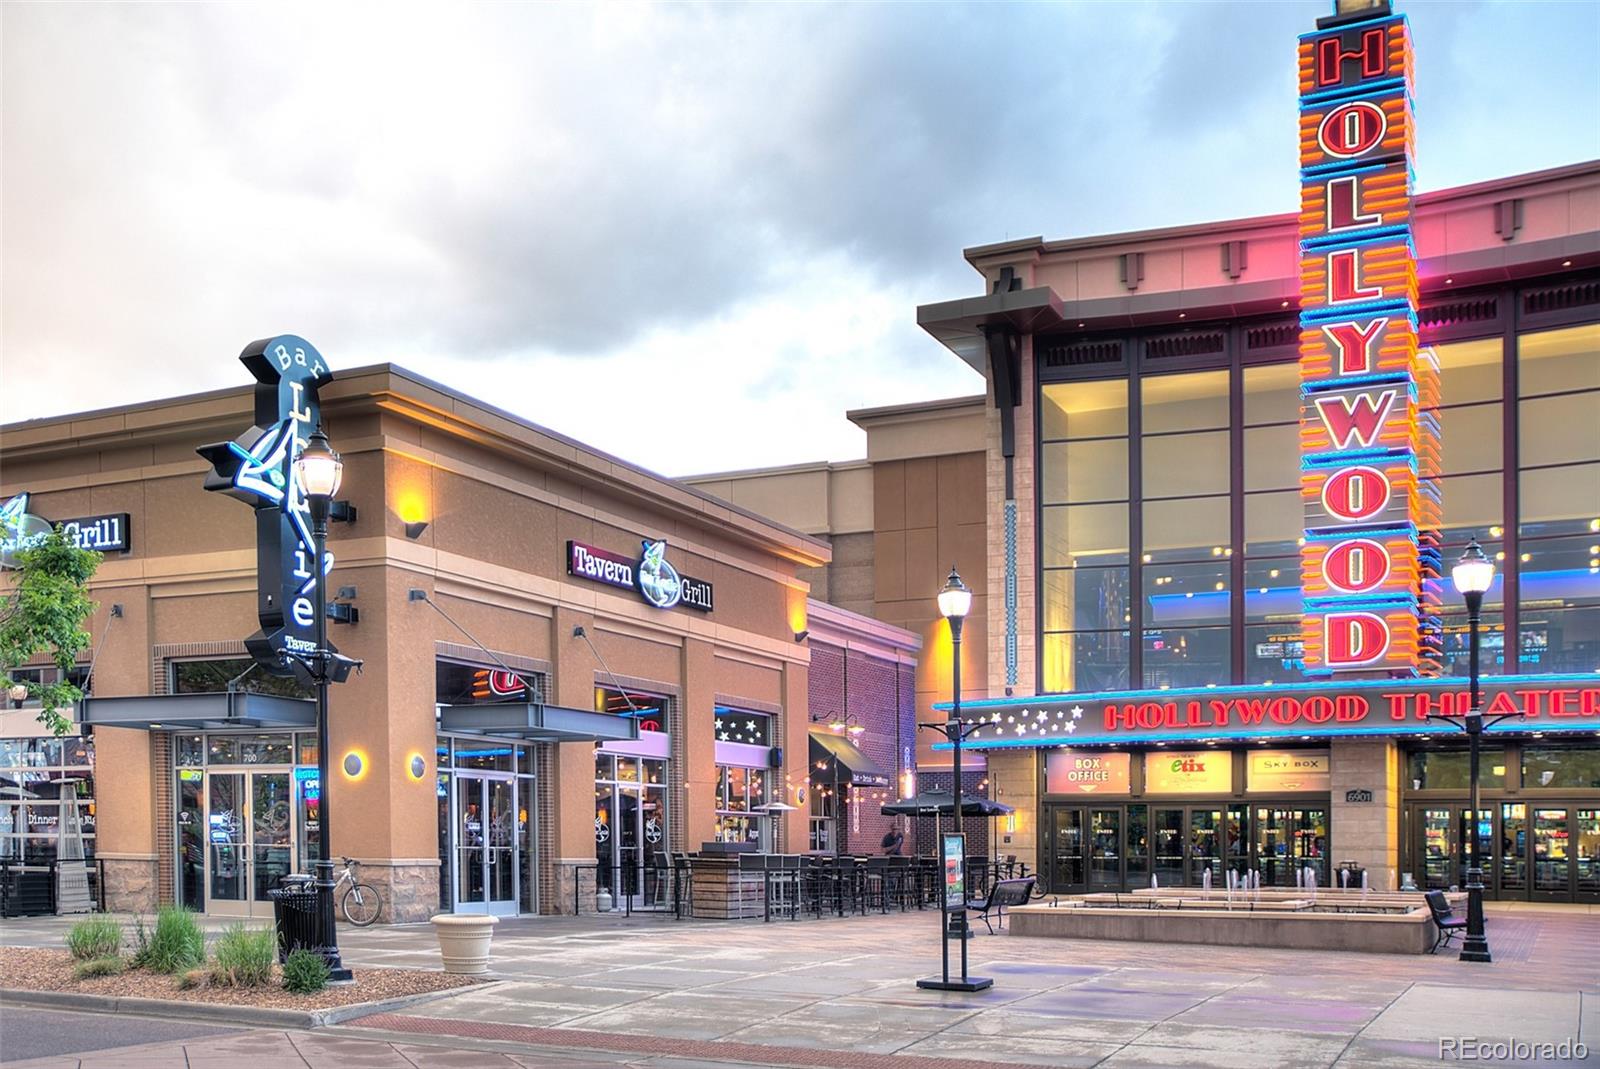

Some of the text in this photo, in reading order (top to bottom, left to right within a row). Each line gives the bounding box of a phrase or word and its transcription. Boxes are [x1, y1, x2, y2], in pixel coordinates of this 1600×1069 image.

[1313, 27, 1397, 667] HOLLYWOOD
[275, 346, 325, 380] Bar
[289, 381, 315, 626] Lie
[64, 517, 121, 549] Grill
[574, 545, 634, 586] Tavern
[681, 578, 712, 608] Grill
[285, 635, 317, 652] Taver
[1104, 694, 1369, 731] HOLLYWOOD
[243, 754, 257, 762] 700
[1075, 758, 1102, 770] BOX
[1171, 758, 1205, 773] etix
[1294, 760, 1319, 768] BOX
[1068, 769, 1109, 783] OFFICE
[1348, 791, 1371, 802] 6901
[28, 812, 58, 825] Dinner
